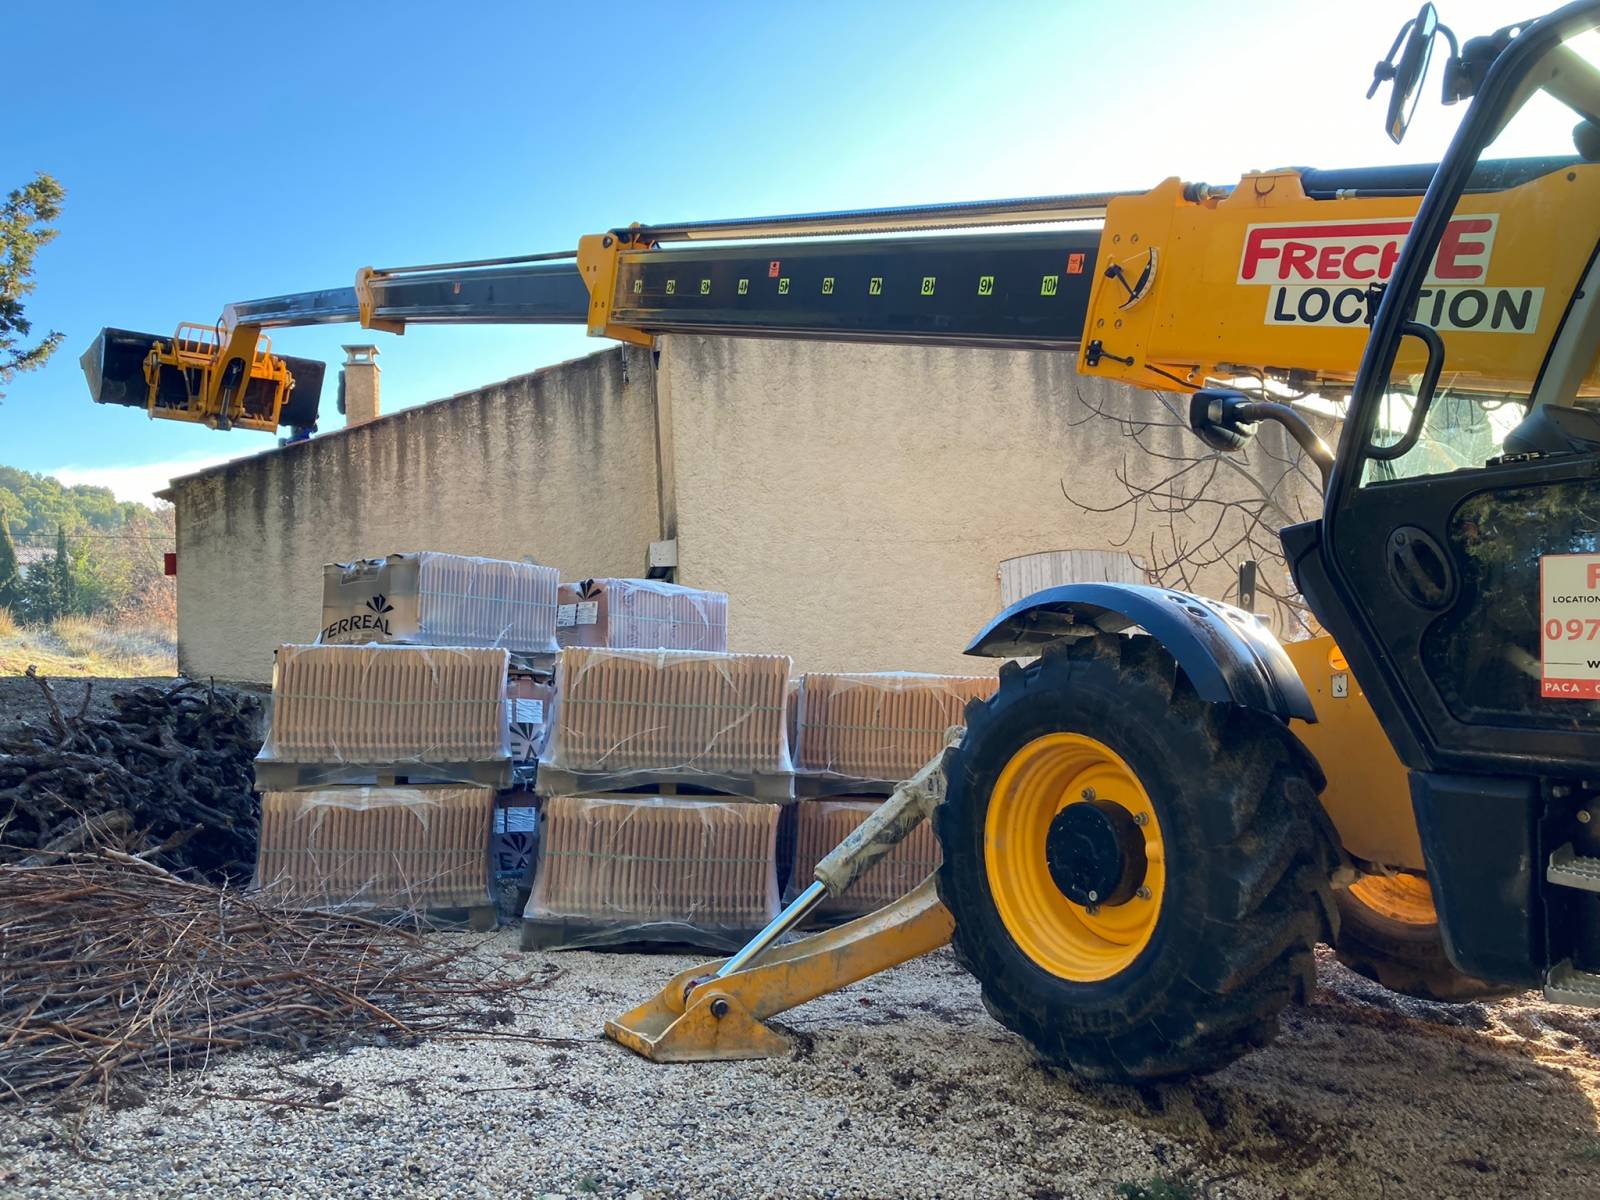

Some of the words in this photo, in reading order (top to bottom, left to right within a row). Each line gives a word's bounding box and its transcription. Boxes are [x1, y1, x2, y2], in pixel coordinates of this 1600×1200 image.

[1043, 278, 1053, 293] 10
[1274, 287, 1533, 330] LOCTION
[320, 614, 393, 644] TERREAL
[1545, 682, 1580, 693] PACA
